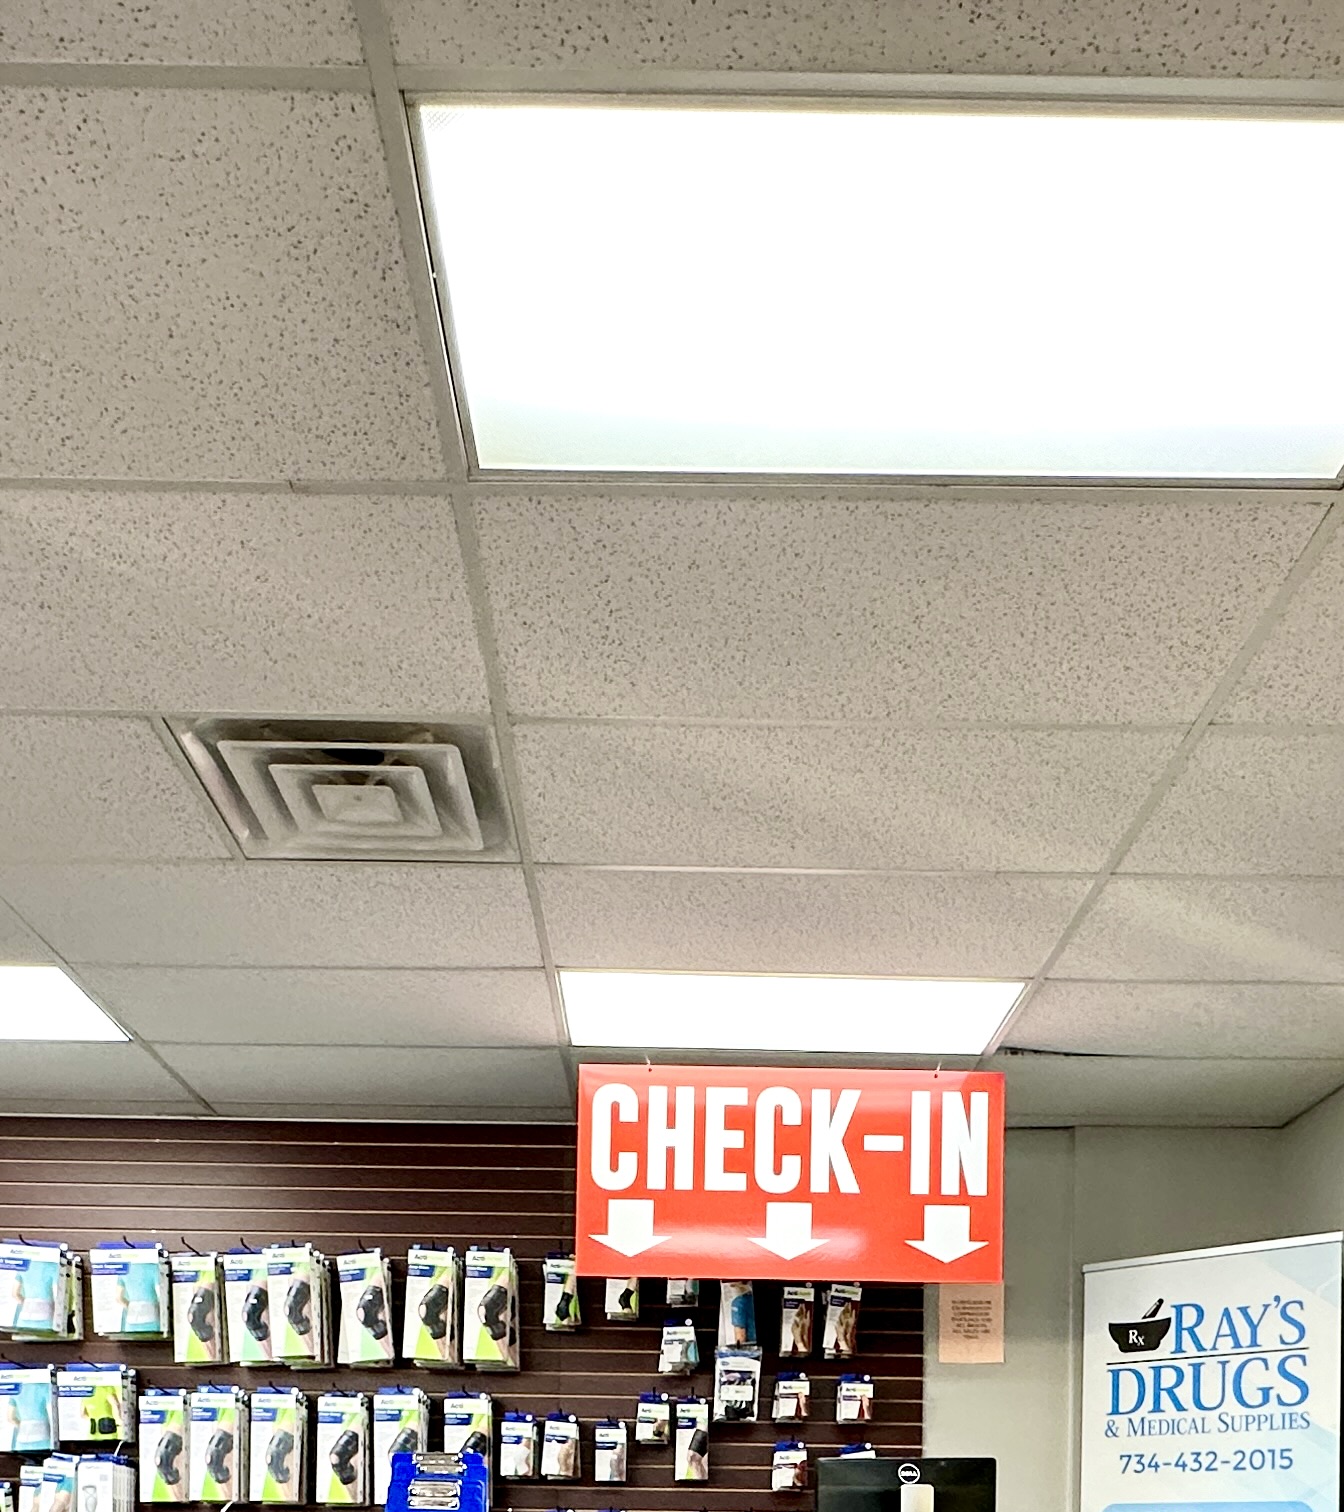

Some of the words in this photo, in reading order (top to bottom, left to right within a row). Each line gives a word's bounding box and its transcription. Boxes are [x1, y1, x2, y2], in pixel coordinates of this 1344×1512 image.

[590, 1082, 990, 1197] CHECK-IN
[1128, 1329, 1145, 1346] Rx
[1170, 1295, 1306, 1354] RAY'S
[1106, 1354, 1309, 1416] DRUGS
[1104, 1419, 1119, 1438] &
[1127, 1416, 1211, 1437] MEDICAL
[1217, 1411, 1310, 1433] SUPPLIES
[1120, 1448, 1294, 1474] 734-432-2015
